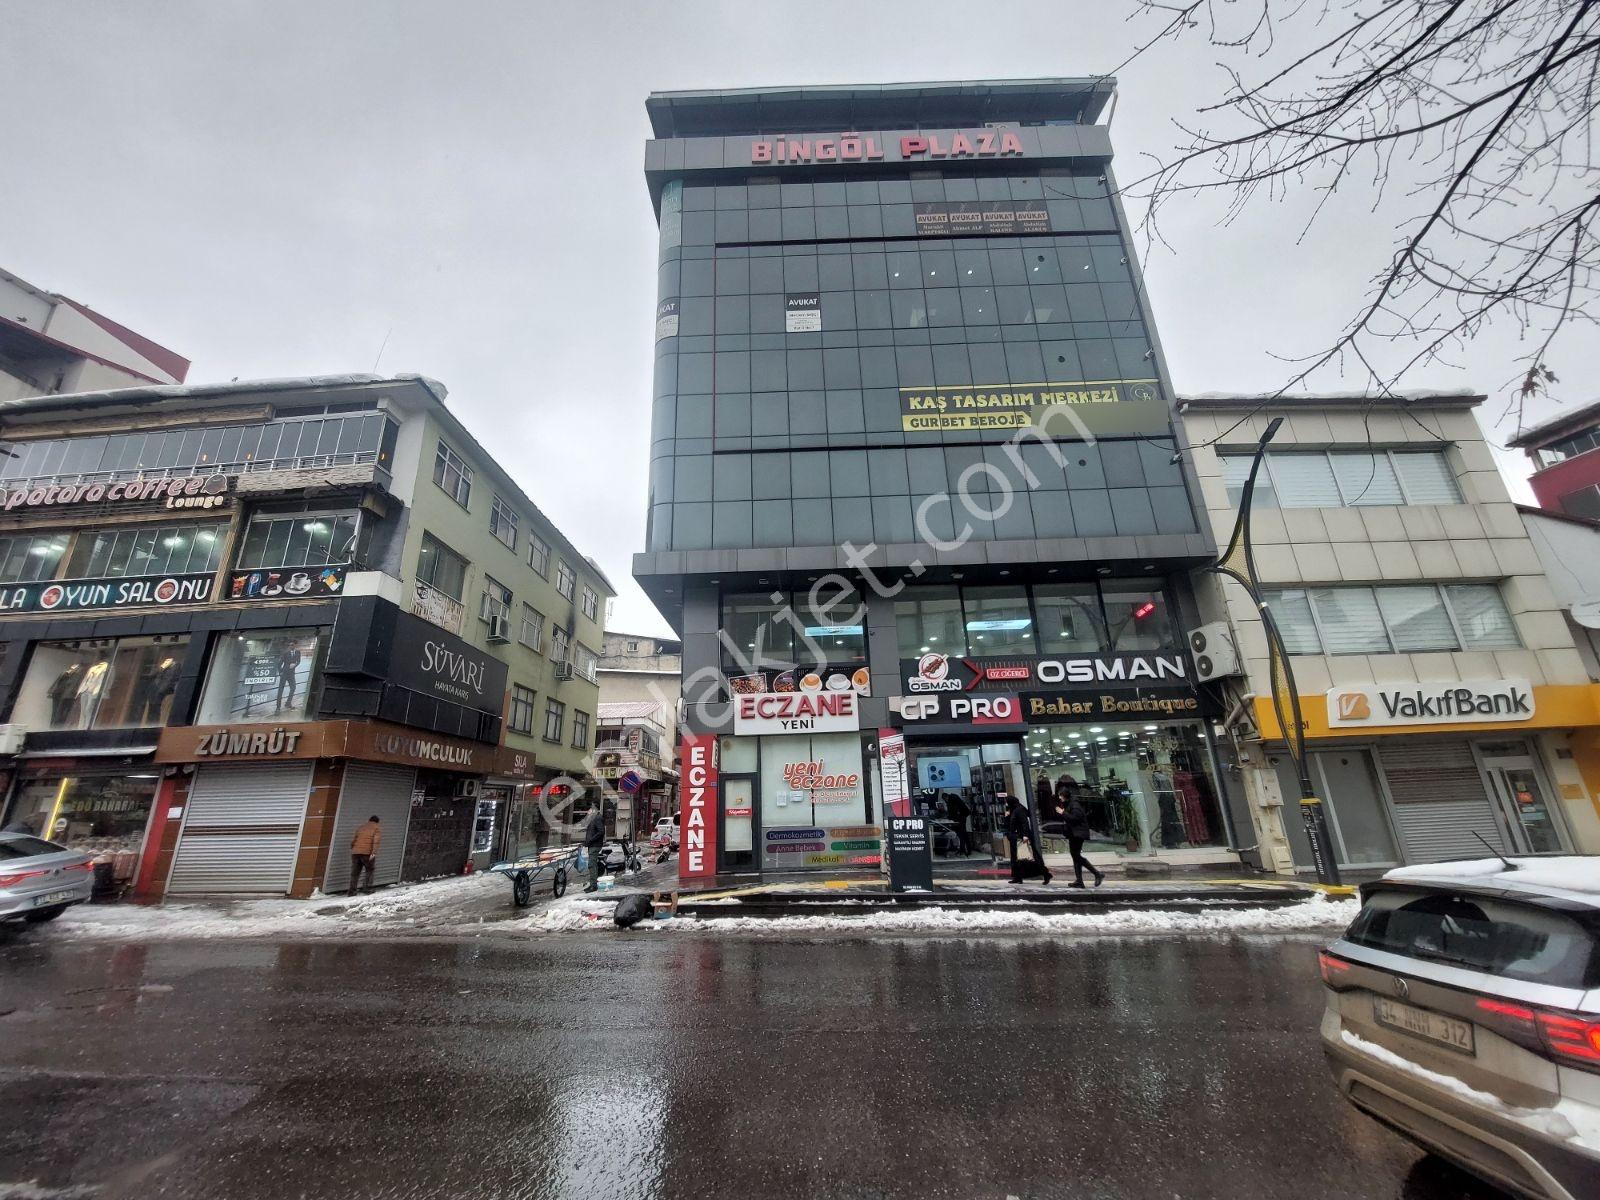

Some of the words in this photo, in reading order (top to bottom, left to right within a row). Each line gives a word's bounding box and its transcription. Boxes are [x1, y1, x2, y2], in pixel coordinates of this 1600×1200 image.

[752, 132, 883, 164] BİNGÖL
[901, 133, 1023, 159] PLAZA
[789, 298, 817, 306] AVUKAT
[910, 396, 947, 413] KAŞ
[953, 392, 1034, 408] TASARIM
[1041, 387, 1119, 405] MERKEZİ
[910, 415, 969, 428] GURBET
[970, 415, 1025, 427] BEROJE
[166, 495, 224, 508] Lounge
[40, 585, 110, 609] OYUN
[115, 578, 211, 604] SALONU
[421, 641, 485, 695] SÜVARİ
[1037, 656, 1186, 683] OSMAN
[911, 681, 960, 691] OSMAN
[741, 694, 853, 719] ECZANE
[900, 700, 939, 720] CP
[950, 697, 1012, 718] PRO
[1030, 697, 1093, 715] Bahar
[1100, 695, 1198, 713] Boutique
[782, 717, 814, 730] YENİ
[194, 728, 300, 755] ZÜMRÜT
[783, 759, 824, 781] yeni
[789, 774, 858, 790] eczane
[687, 746, 707, 872] ECZANE
[893, 820, 904, 829] CP
[906, 820, 923, 829] PRO
